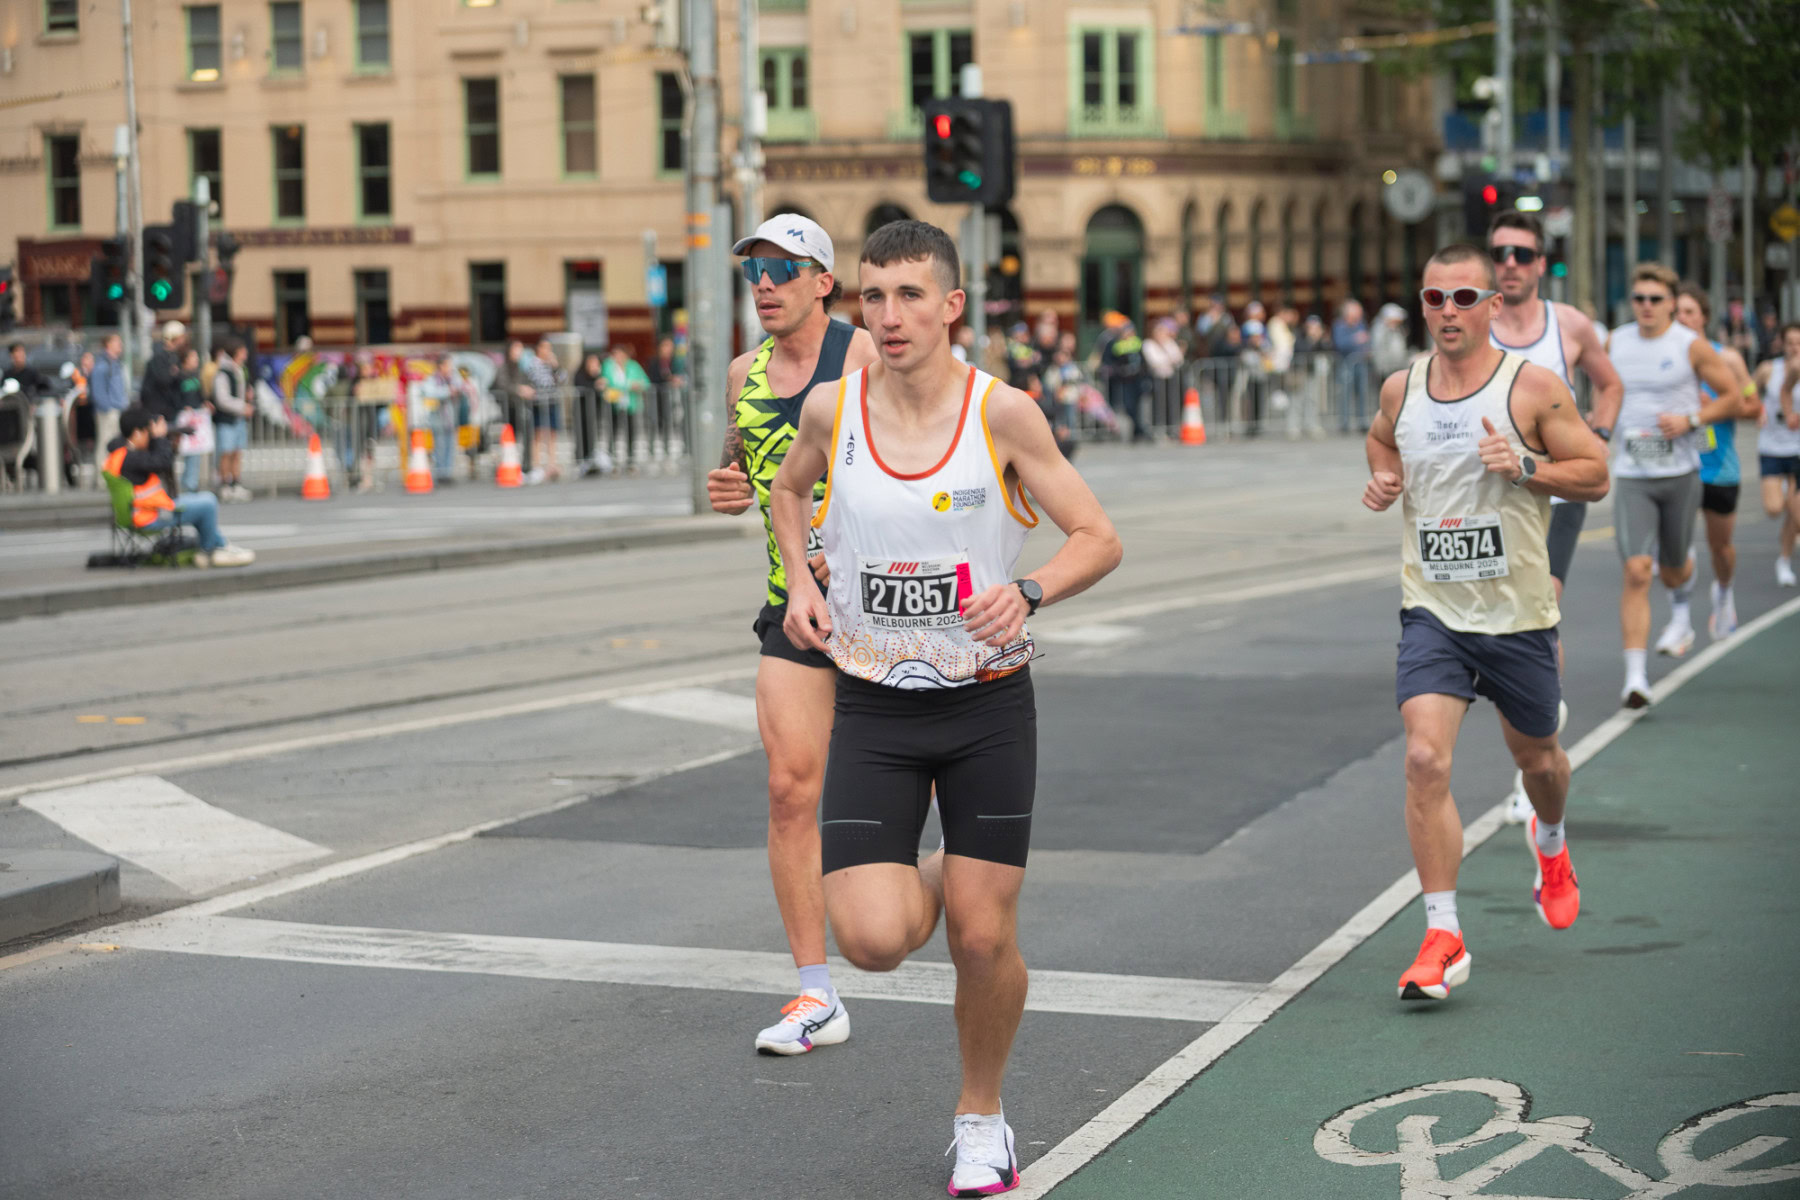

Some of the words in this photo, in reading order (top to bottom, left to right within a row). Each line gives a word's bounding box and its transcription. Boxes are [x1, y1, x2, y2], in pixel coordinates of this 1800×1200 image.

[845, 441, 855, 466] EVO
[952, 494, 986, 502] MARATHON
[952, 499, 986, 508] FOUNDATION
[1426, 529, 1496, 561] 28574
[1429, 561, 1474, 571] MELBOURNE
[1477, 559, 1499, 568] 2025
[869, 575, 958, 614] 27857
[872, 615, 933, 628] MELBOURNE
[936, 614, 964, 626] 2025
